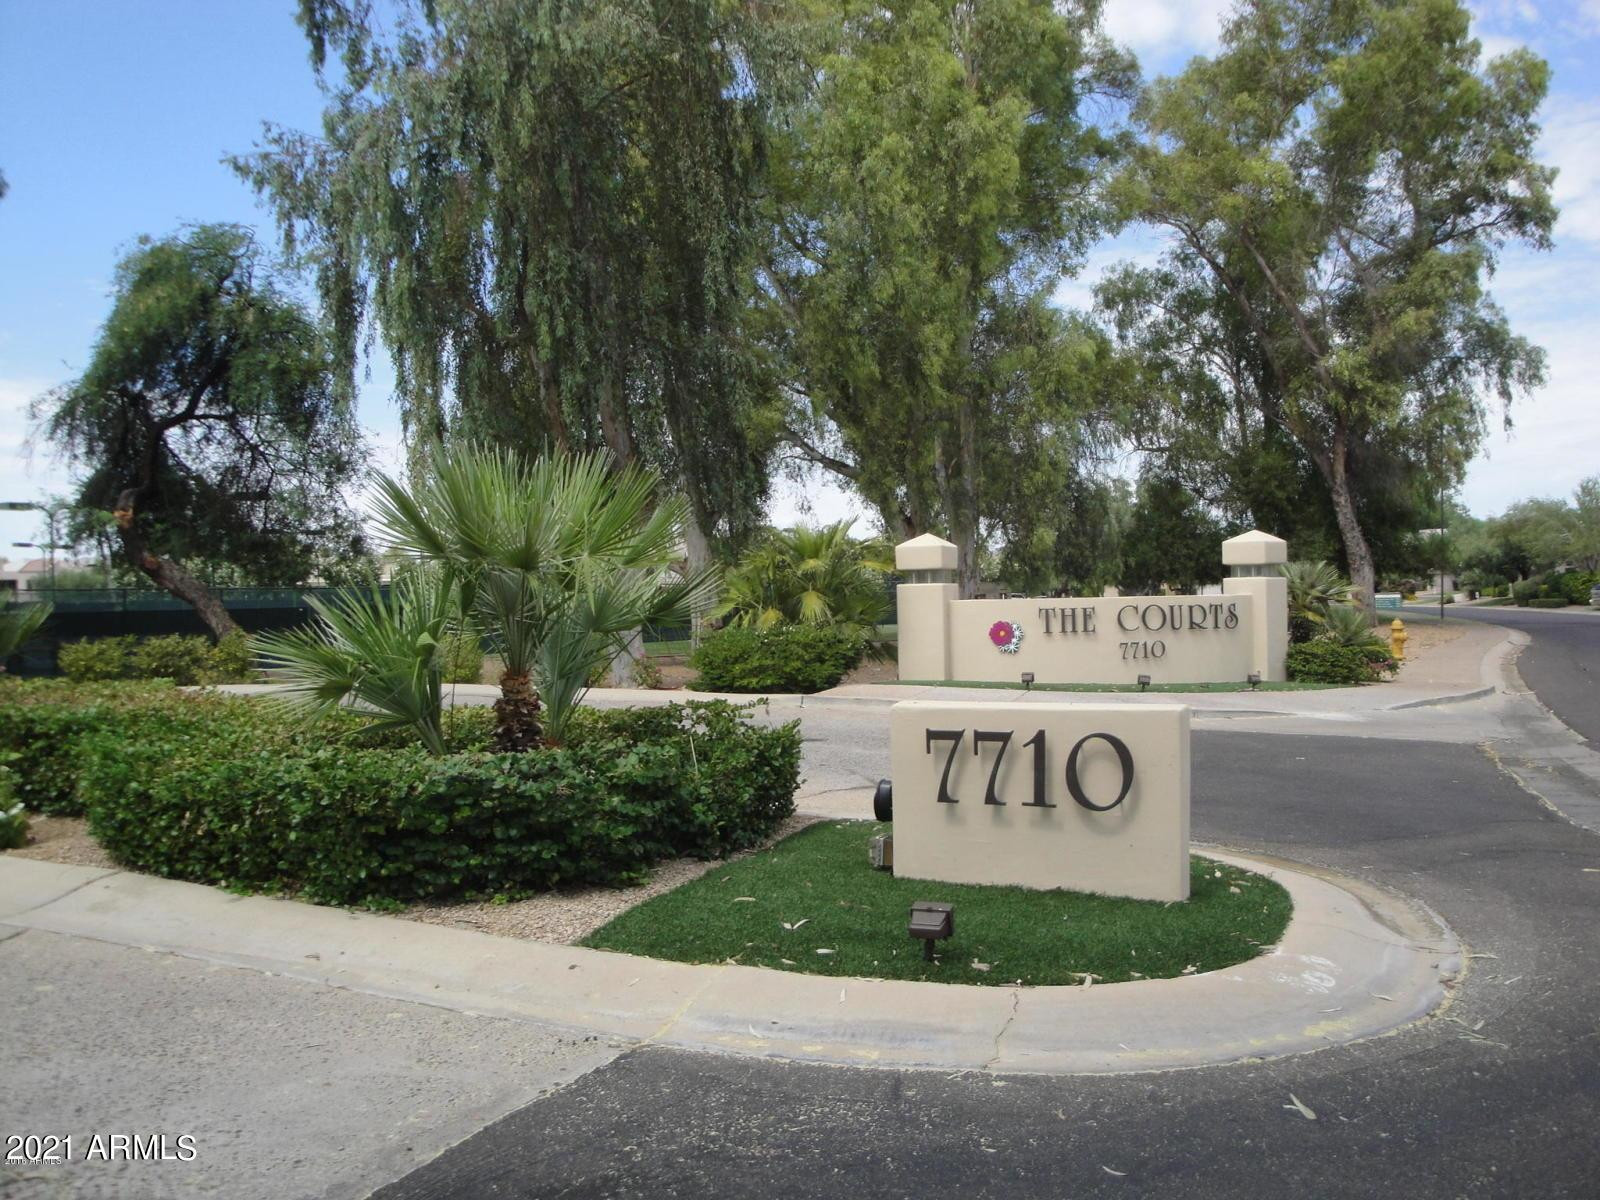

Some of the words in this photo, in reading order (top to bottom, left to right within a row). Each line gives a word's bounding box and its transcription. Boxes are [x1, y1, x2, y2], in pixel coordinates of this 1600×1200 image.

[1038, 606, 1096, 634] THE
[1116, 602, 1240, 632] COURTS
[1119, 640, 1166, 661] 7710
[926, 728, 1134, 811] 7710
